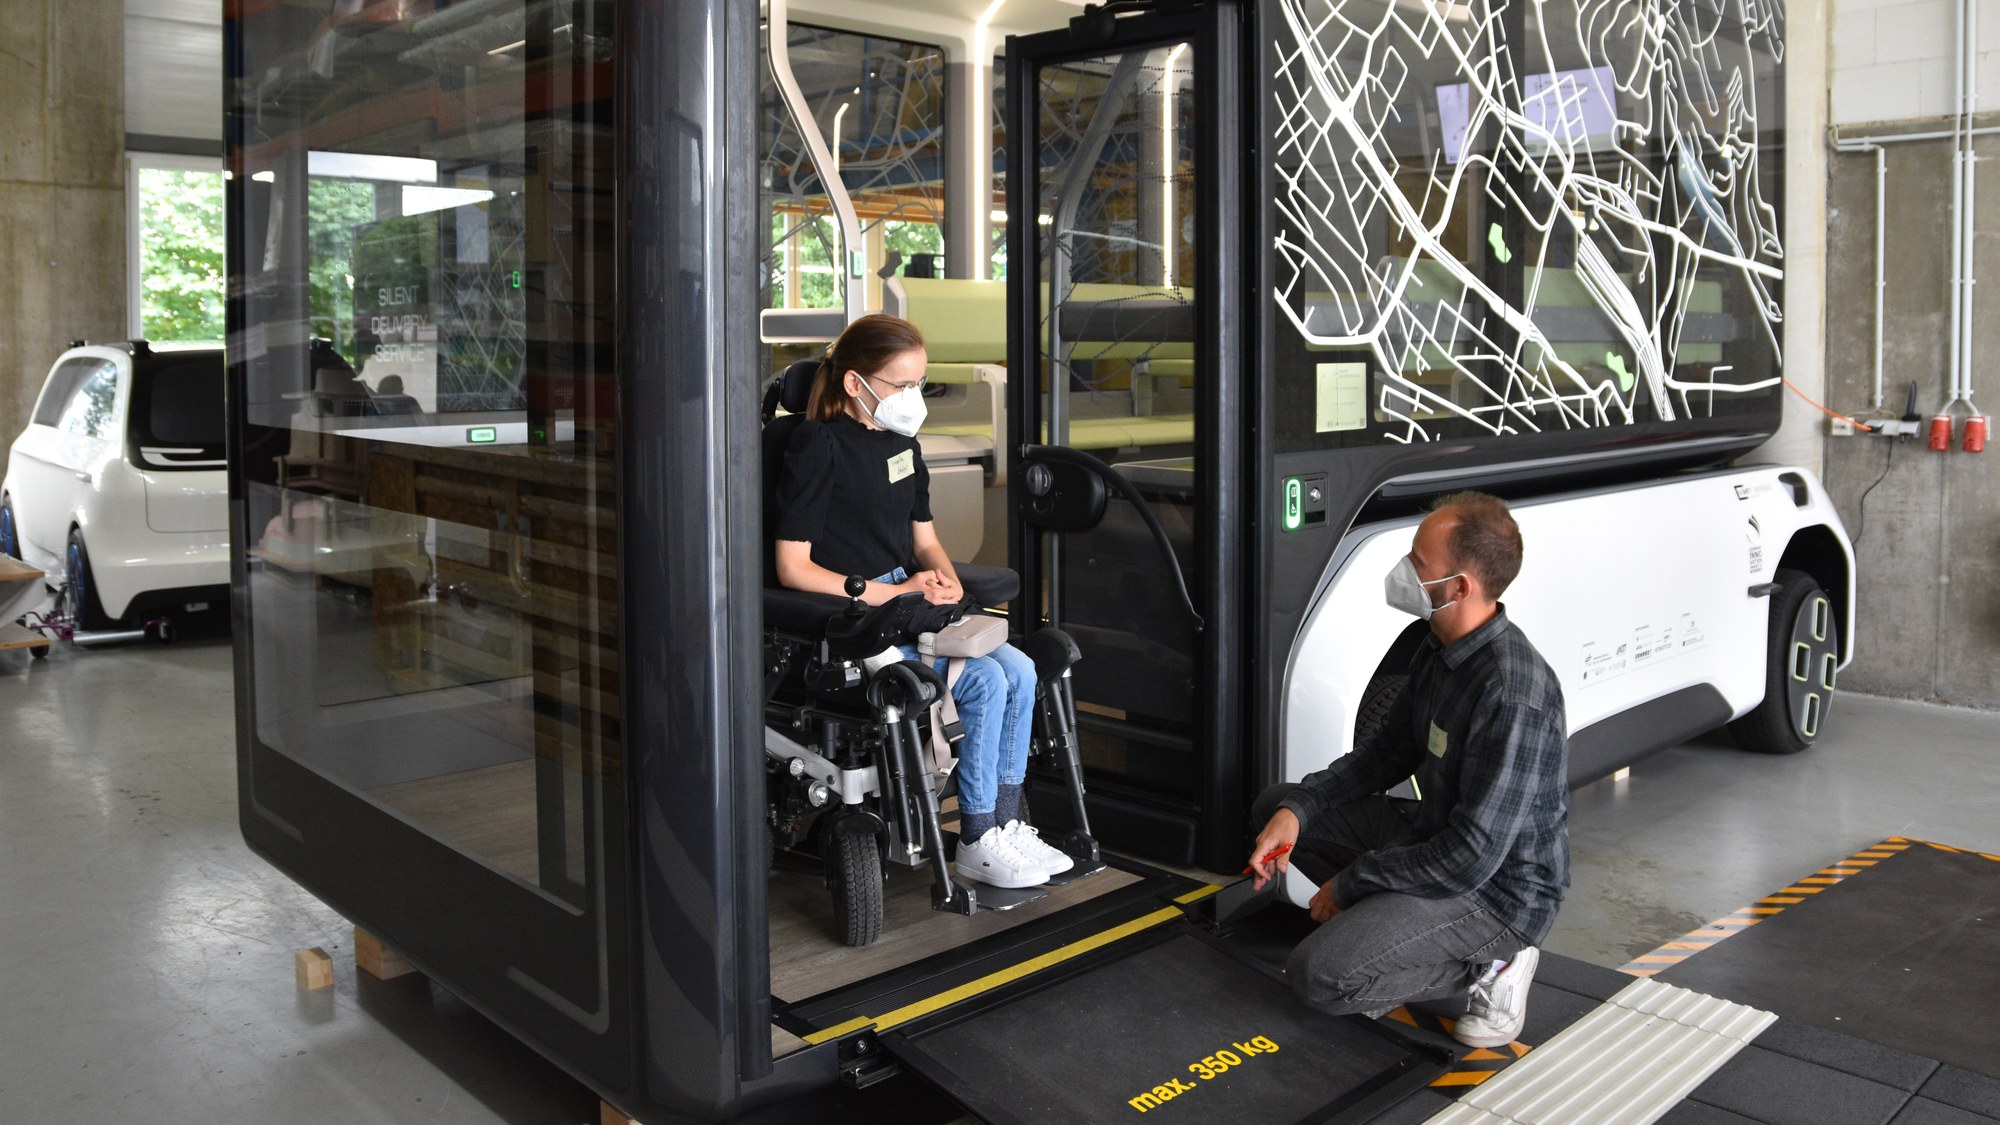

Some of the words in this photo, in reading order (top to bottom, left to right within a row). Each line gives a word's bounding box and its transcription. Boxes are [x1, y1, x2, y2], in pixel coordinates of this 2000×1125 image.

[378, 285, 420, 306] SILENT
[371, 314, 427, 335] DELIVERY
[375, 343, 425, 363] SERVICE
[1128, 1078, 1197, 1113] max.
[1188, 1049, 1243, 1080] 350
[1232, 1034, 1280, 1057] kg
